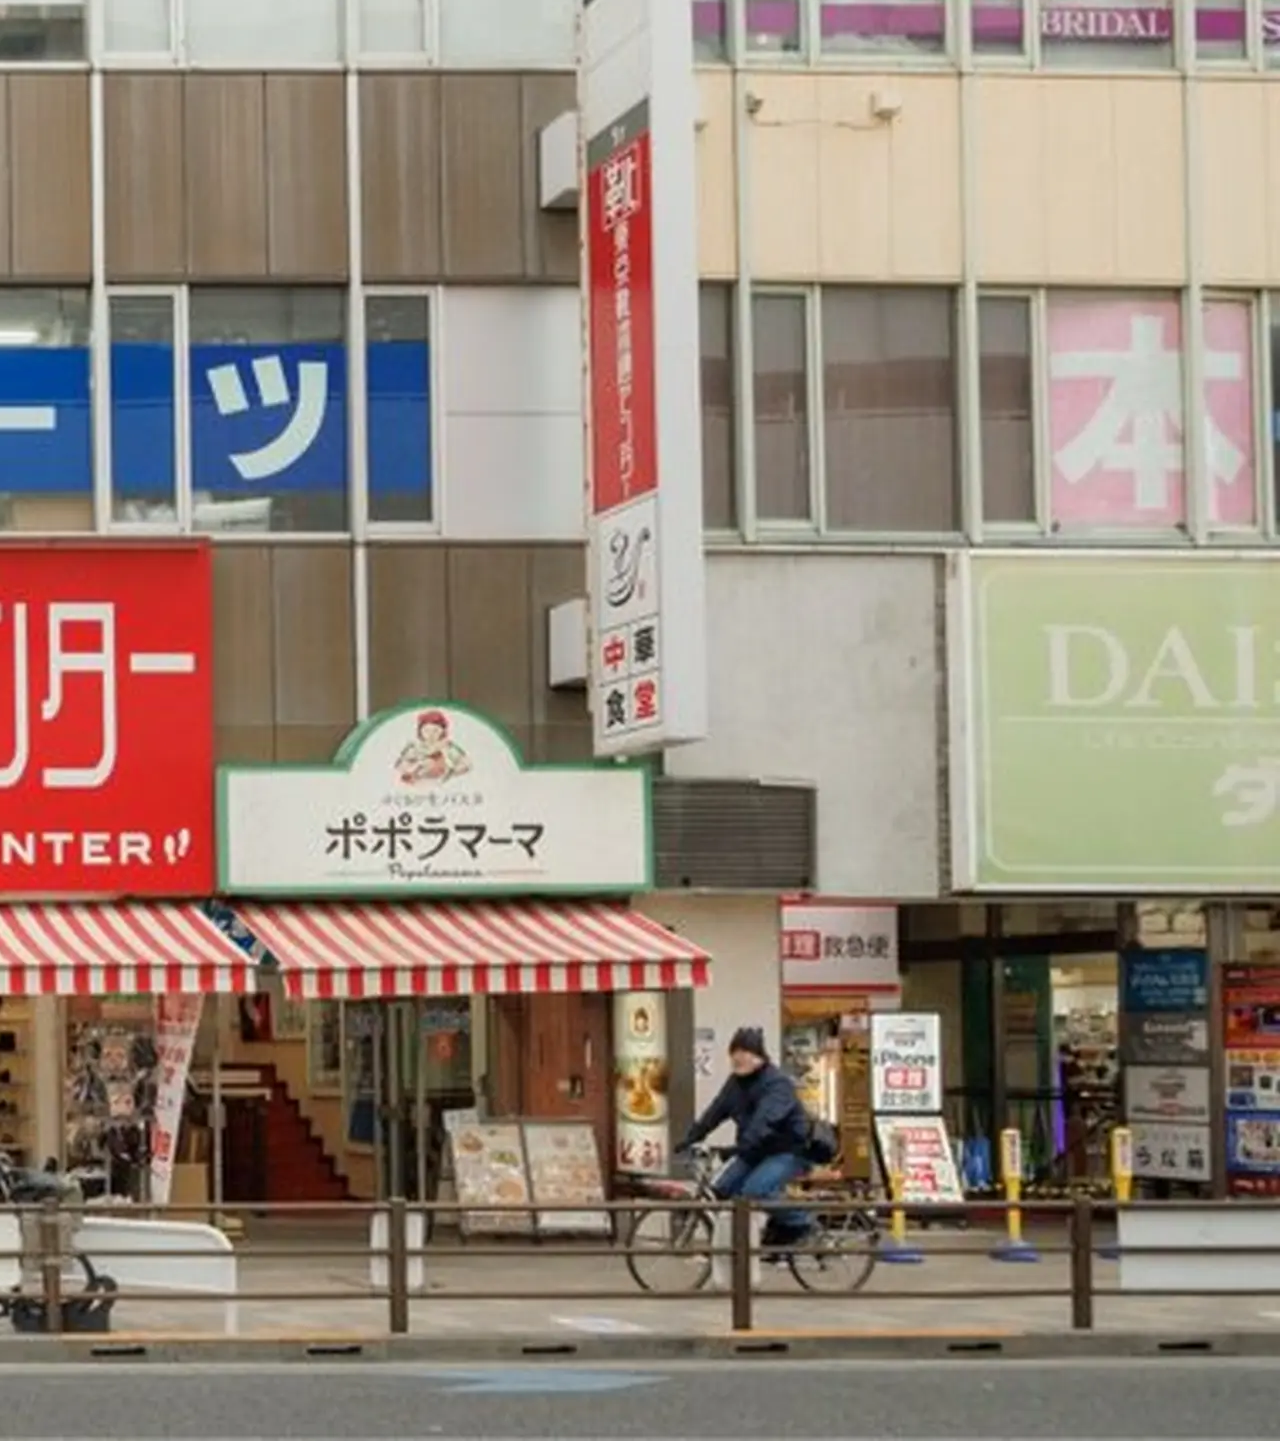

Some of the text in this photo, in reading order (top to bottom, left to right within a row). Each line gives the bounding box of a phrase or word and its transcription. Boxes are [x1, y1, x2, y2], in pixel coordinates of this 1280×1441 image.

[1041, 11, 1170, 37] BRIDAL
[1051, 315, 1247, 510] 本
[1043, 623, 1280, 708] DAI
[325, 811, 545, 860] ポポラマーマ
